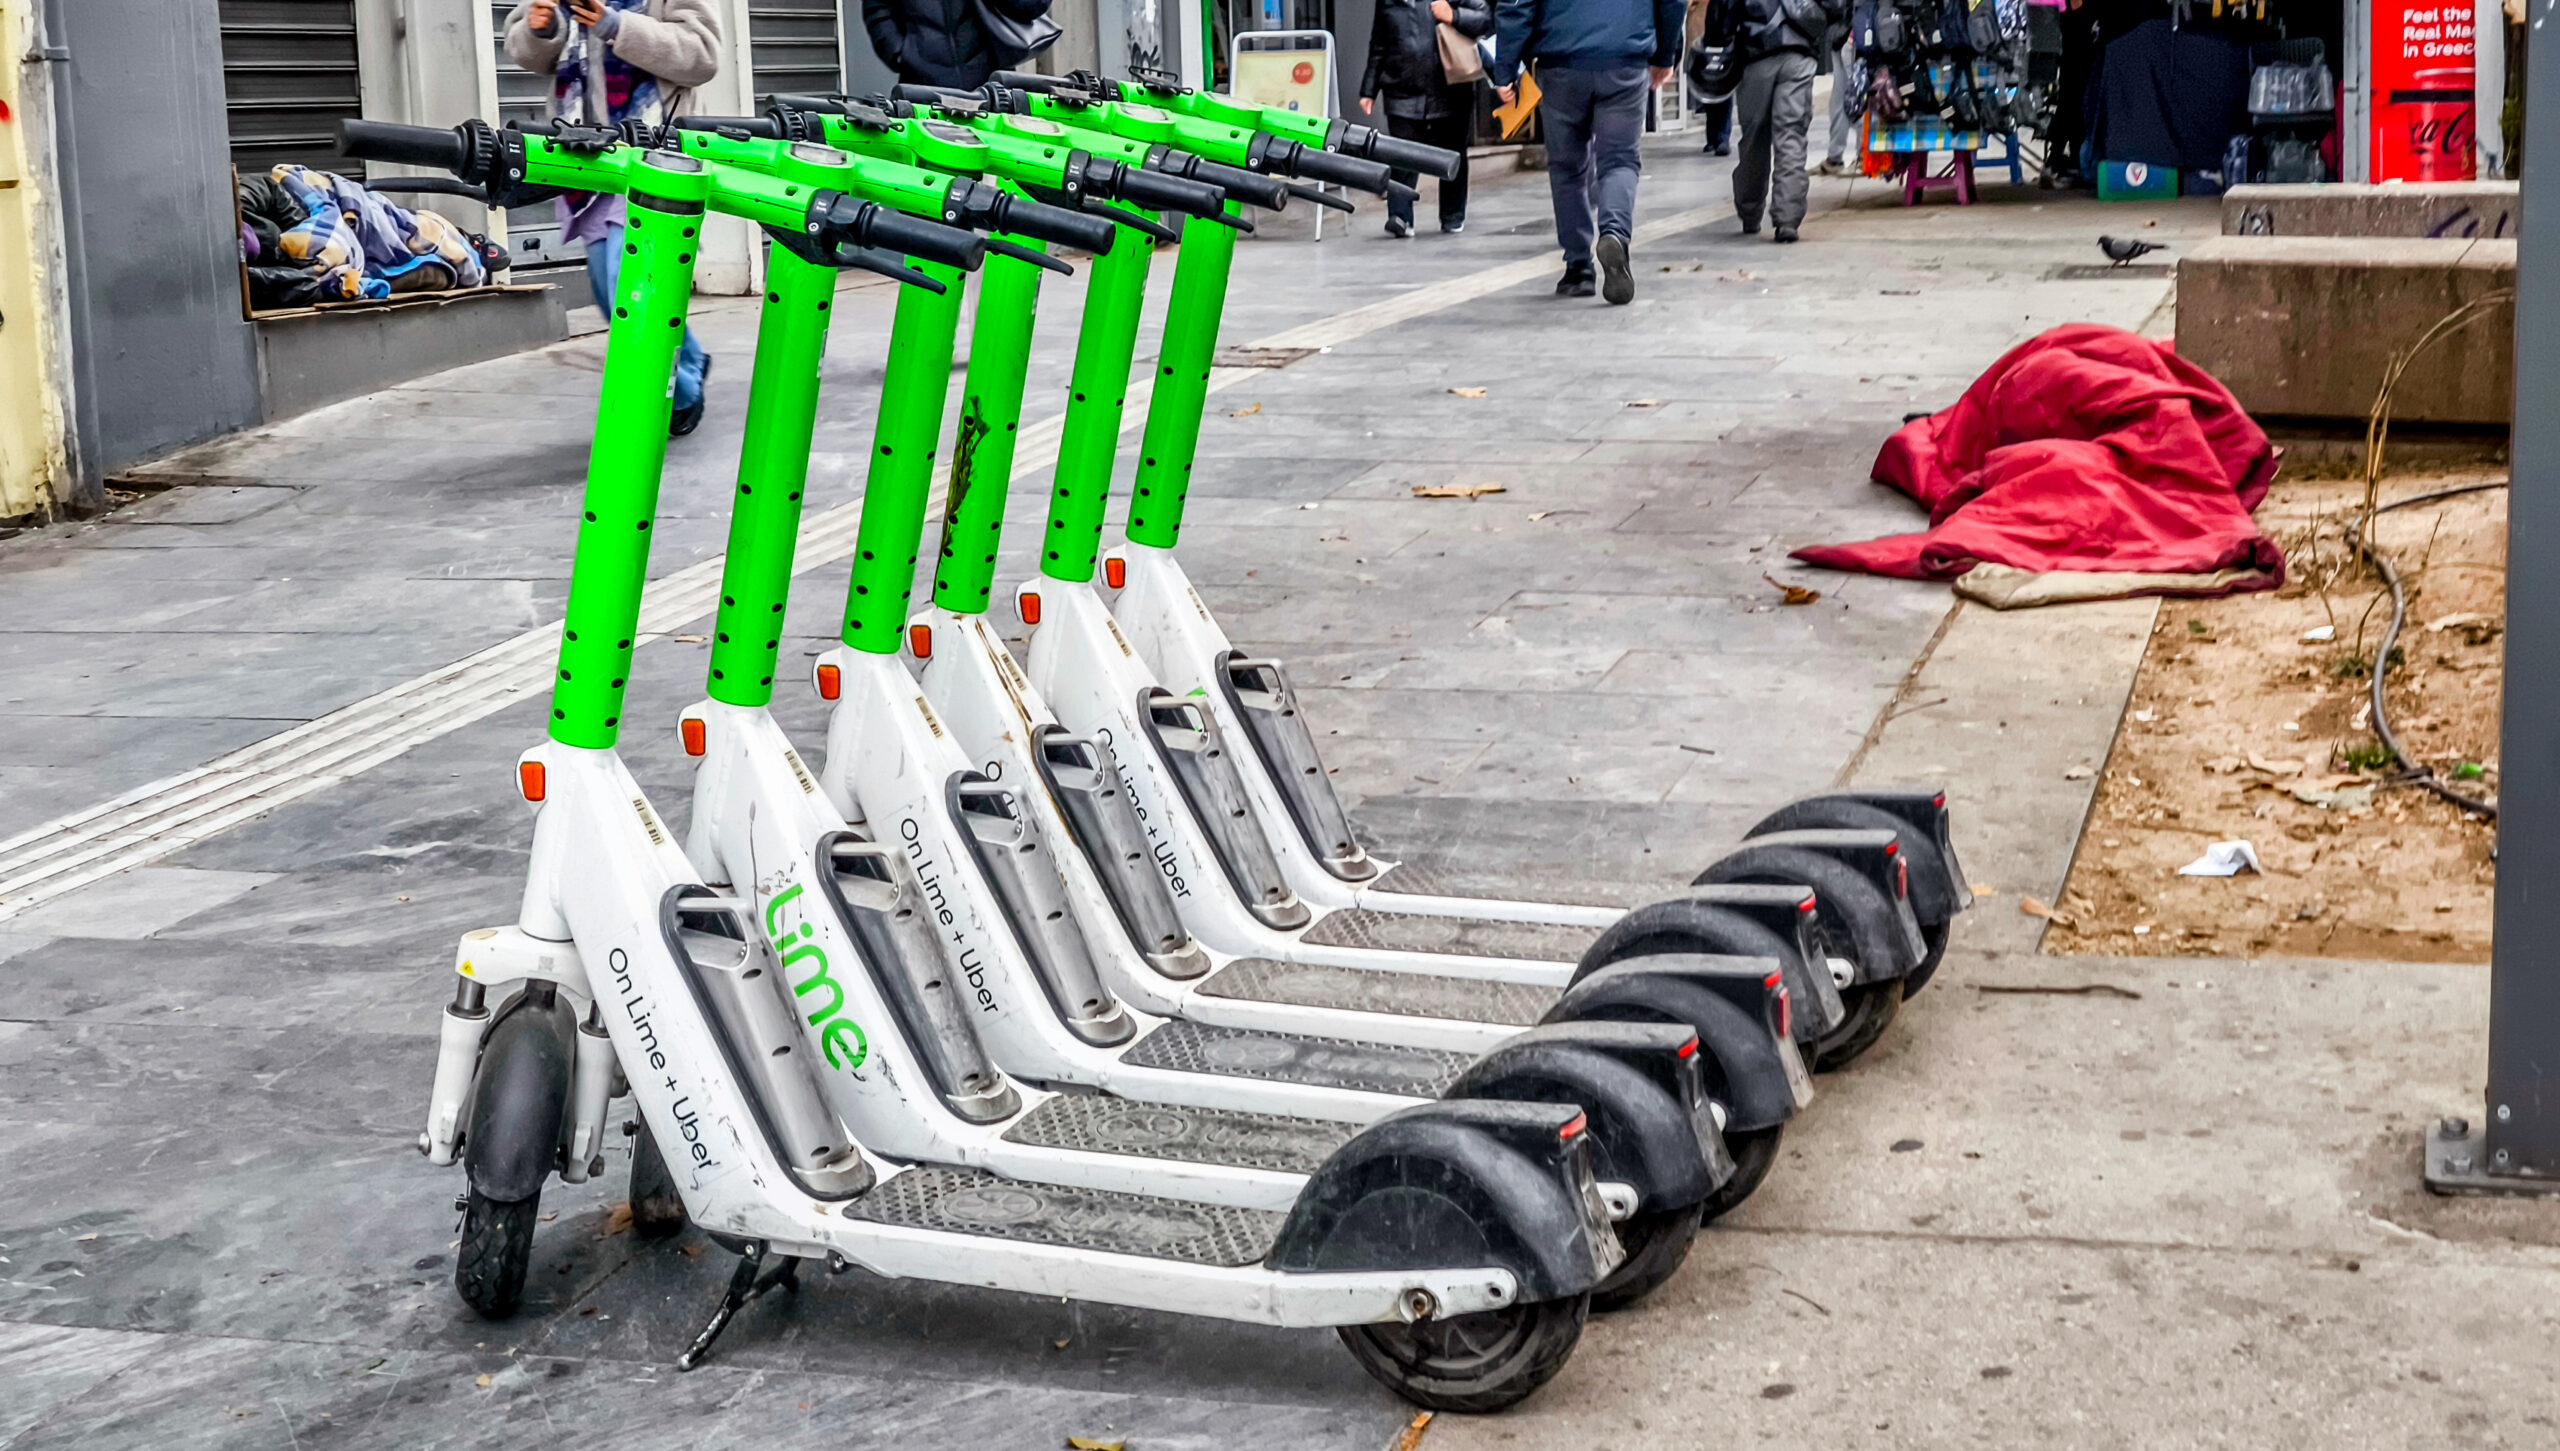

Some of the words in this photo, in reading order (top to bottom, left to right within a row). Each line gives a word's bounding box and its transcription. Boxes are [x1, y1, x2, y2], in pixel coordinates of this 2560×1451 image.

[2403, 7, 2439, 24] Feel
[2443, 6, 2472, 22] the
[2403, 24, 2441, 41] Real
[2423, 41, 2476, 58] Greec
[1148, 826, 1158, 839] +
[1154, 841, 1191, 898] Uber
[900, 817, 923, 860] On
[917, 860, 954, 926] Lime
[953, 931, 965, 945] +
[960, 948, 999, 1013] Uber
[766, 883, 867, 1071] Lime
[609, 947, 633, 994] On
[627, 996, 666, 1071] Lime
[665, 1076, 677, 1092] +
[672, 1096, 714, 1170] Uber
